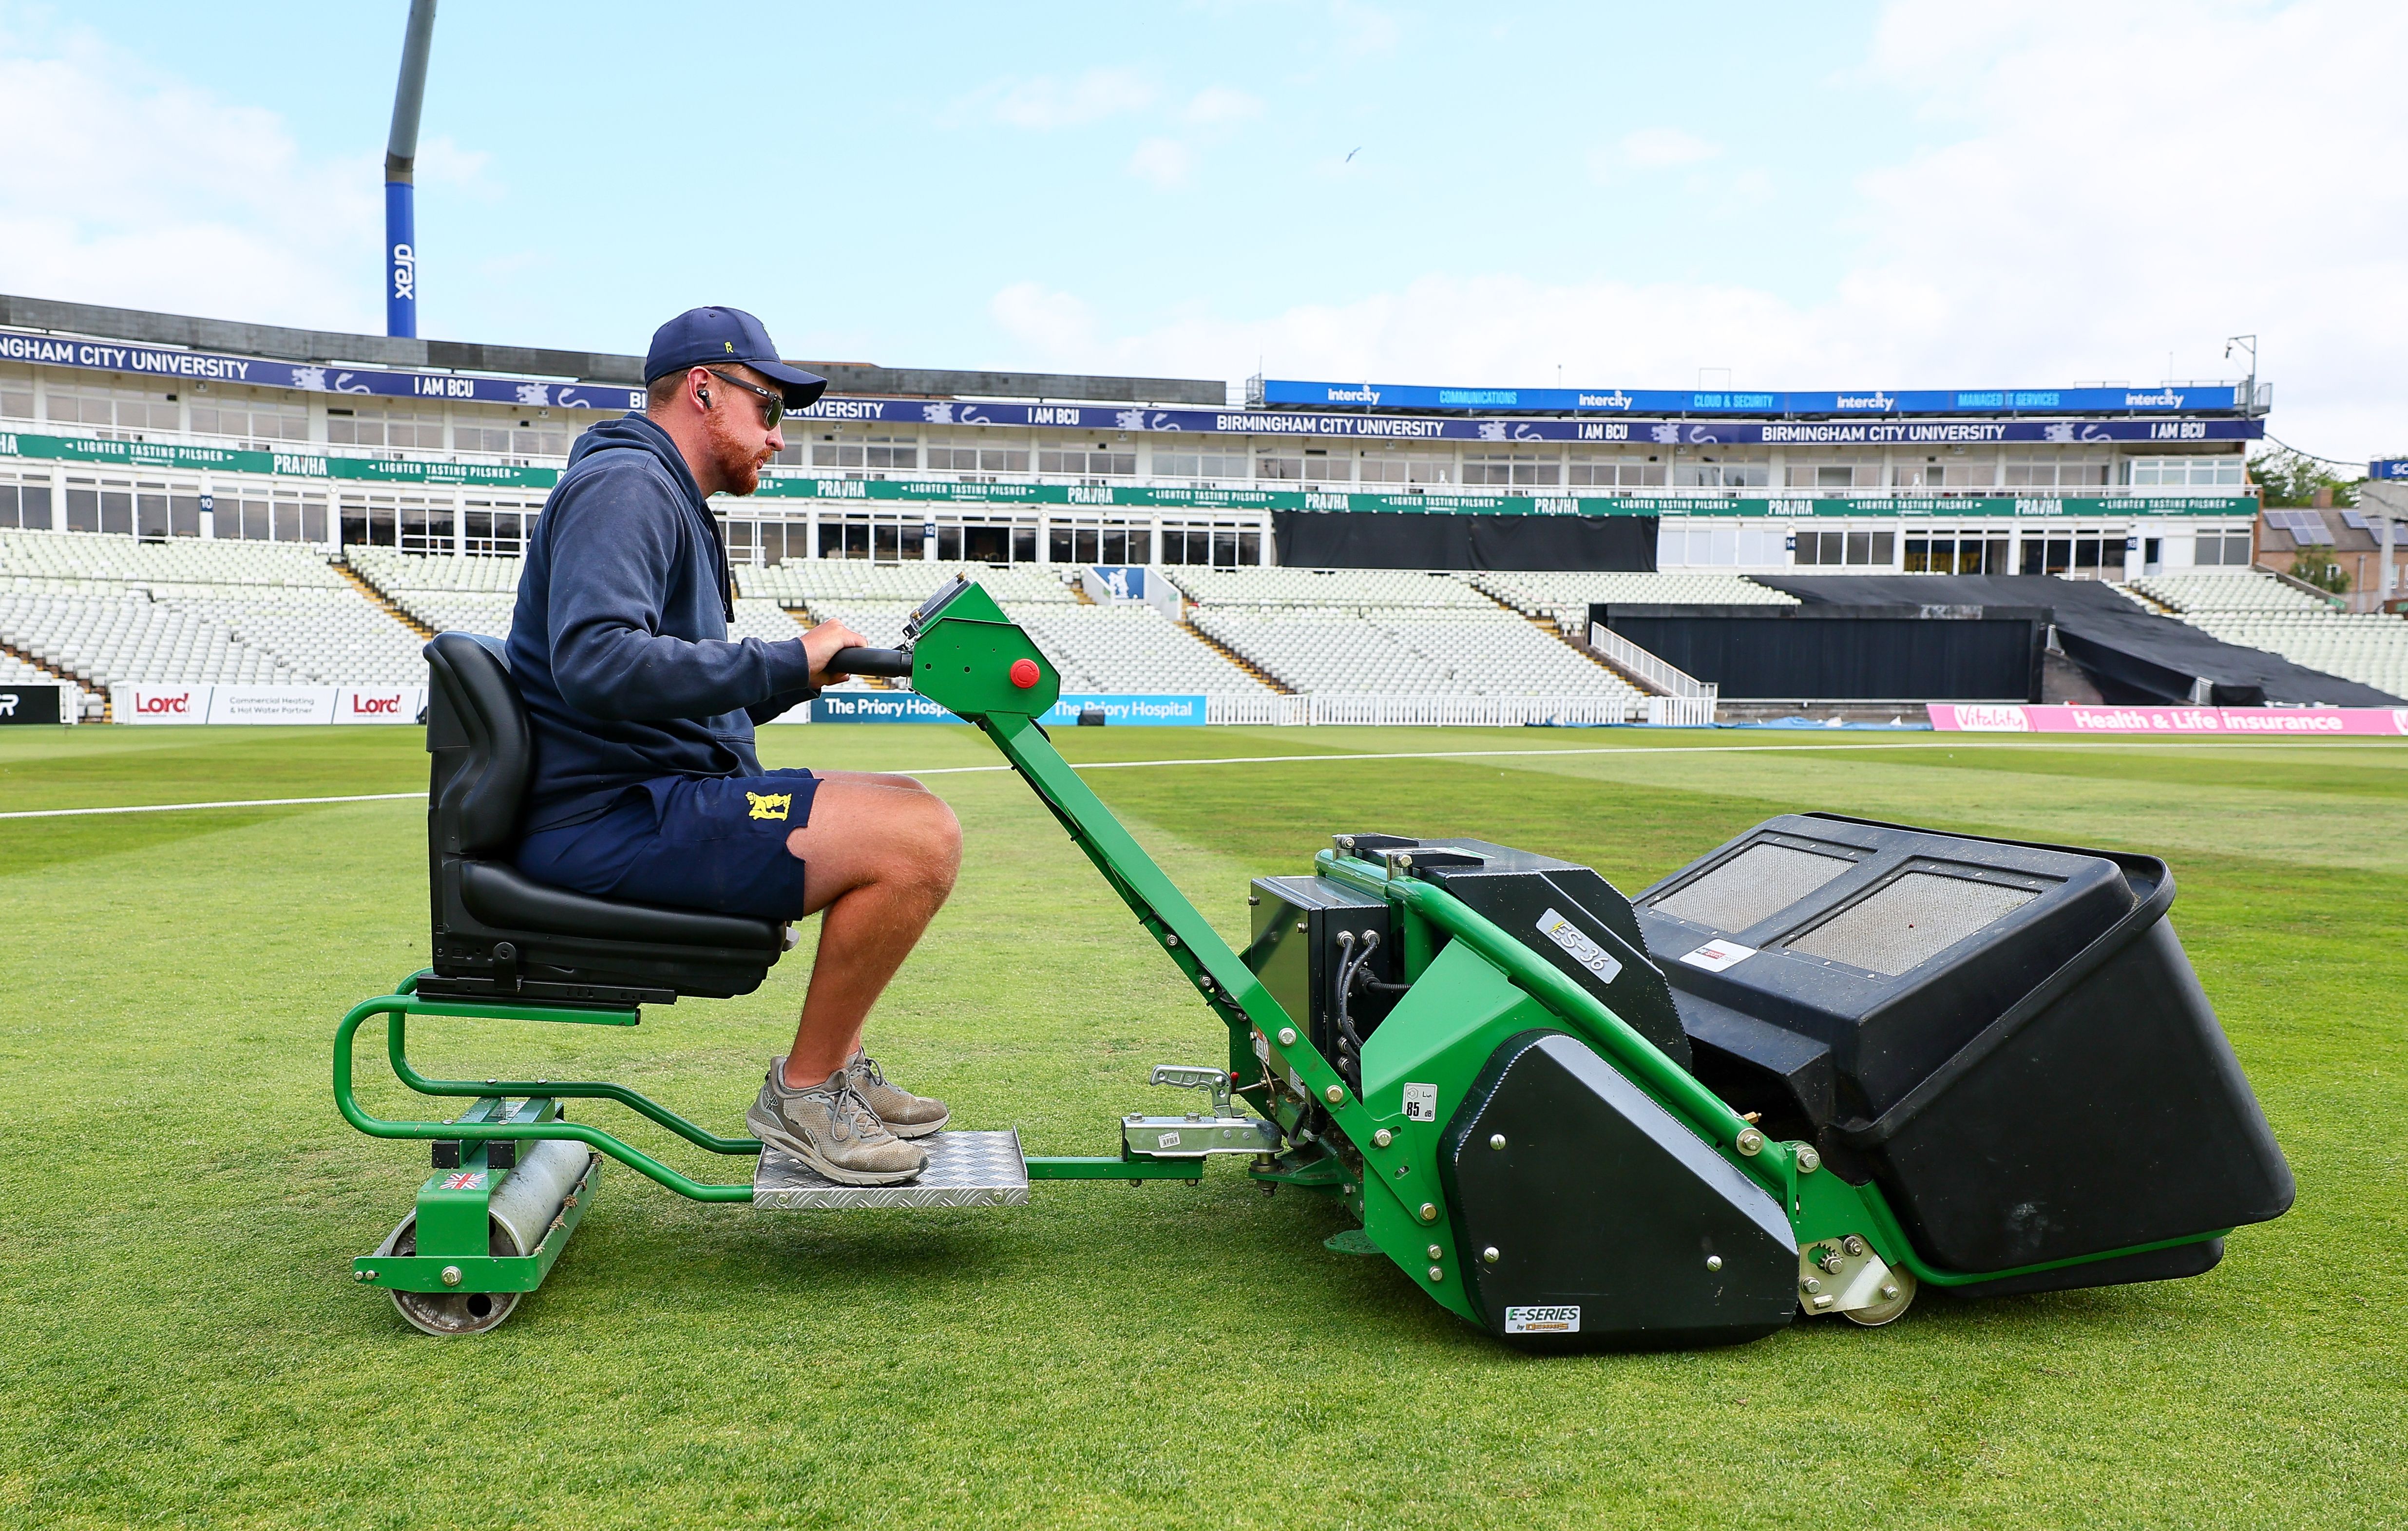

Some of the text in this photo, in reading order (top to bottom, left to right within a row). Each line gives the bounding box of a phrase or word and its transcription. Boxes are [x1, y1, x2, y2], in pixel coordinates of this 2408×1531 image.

[394, 244, 415, 300] drax
[79, 346, 126, 367] CITY
[131, 351, 249, 379] UNIVERSITY
[414, 376, 474, 397] I AM BCU
[1440, 391, 1517, 405] COMMUNICATIONS
[1694, 394, 1774, 408] CLOUD & SECURITY
[1958, 393, 2060, 407] MANAGED IT SERVICES
[1027, 407, 1080, 425] I AM BCU
[1217, 415, 1444, 437] BIRMINGHAM CITY UNIVERSITY
[1578, 424, 1628, 439] I AM BCU
[1762, 425, 2006, 441] BIRMINGHAM CITY UNIVERSITY
[2151, 422, 2205, 438] I AM BCU
[77, 440, 125, 455] LIGHTER
[129, 444, 175, 458] TASTING
[179, 448, 223, 462] PILSNER
[273, 454, 327, 475] PRAVHA
[379, 462, 511, 478] LIGHTER TASTING PILSNER
[817, 480, 865, 497] PRAVHA
[910, 484, 1027, 496] LIGHTER TASTING PILSNER
[1068, 487, 1114, 504] PRAVHA
[1156, 490, 1266, 502] LIGHTER TASTING PILSNER
[200, 498, 213, 509] 10
[1305, 493, 1349, 510] PRAVHA
[1389, 496, 1495, 508] LIGHTER TASTING PILSNER
[1534, 498, 1579, 513] PRAVHA
[1620, 499, 1729, 510] LIGHTER TASTING PILSNER
[1768, 500, 1813, 515] PRAVHA
[1857, 500, 1973, 510] LIGHTER TASTING PILSNER
[2015, 499, 2063, 514] PRAVHA
[2107, 499, 2226, 509] LIGHTER TASTING PILSNER
[925, 526, 935, 535] 12
[825, 698, 855, 714] The
[858, 699, 904, 717] Priory
[1054, 701, 1080, 716] The
[1132, 701, 1192, 719] Hospital
[1958, 706, 2023, 731] Vitality
[2073, 710, 2342, 730] Health & Life insurance
[1550, 924, 1609, 970] ES-36
[1407, 1102, 1419, 1116] 85
[1509, 1307, 1578, 1321] E-SERIES
